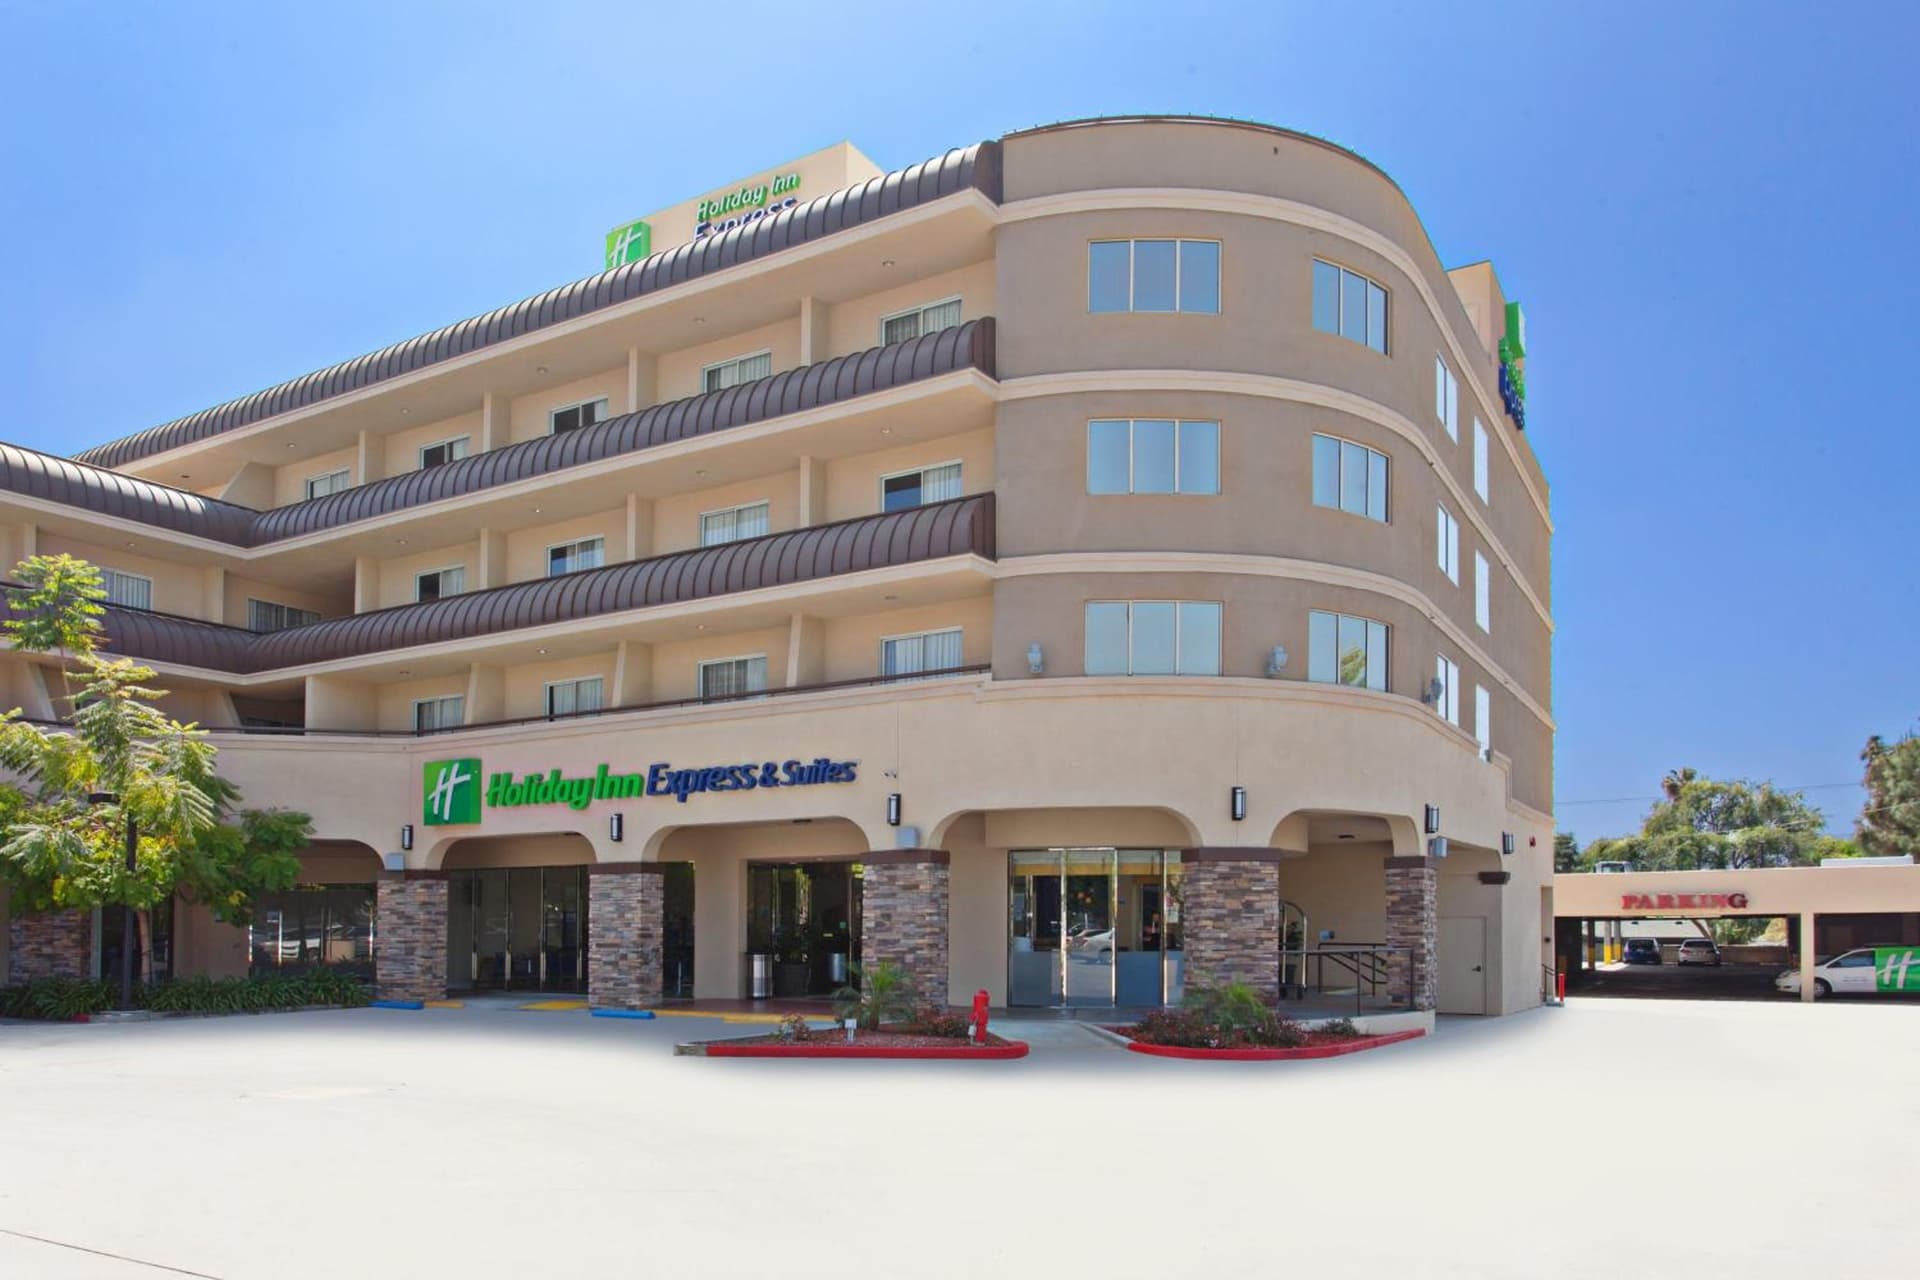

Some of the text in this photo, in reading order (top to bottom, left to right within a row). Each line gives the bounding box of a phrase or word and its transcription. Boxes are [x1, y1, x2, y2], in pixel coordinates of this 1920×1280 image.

[697, 173, 801, 222] Holiday Inn
[486, 758, 857, 811] Holiday Inn Express & Suites
[1621, 892, 1749, 910] PARKING
